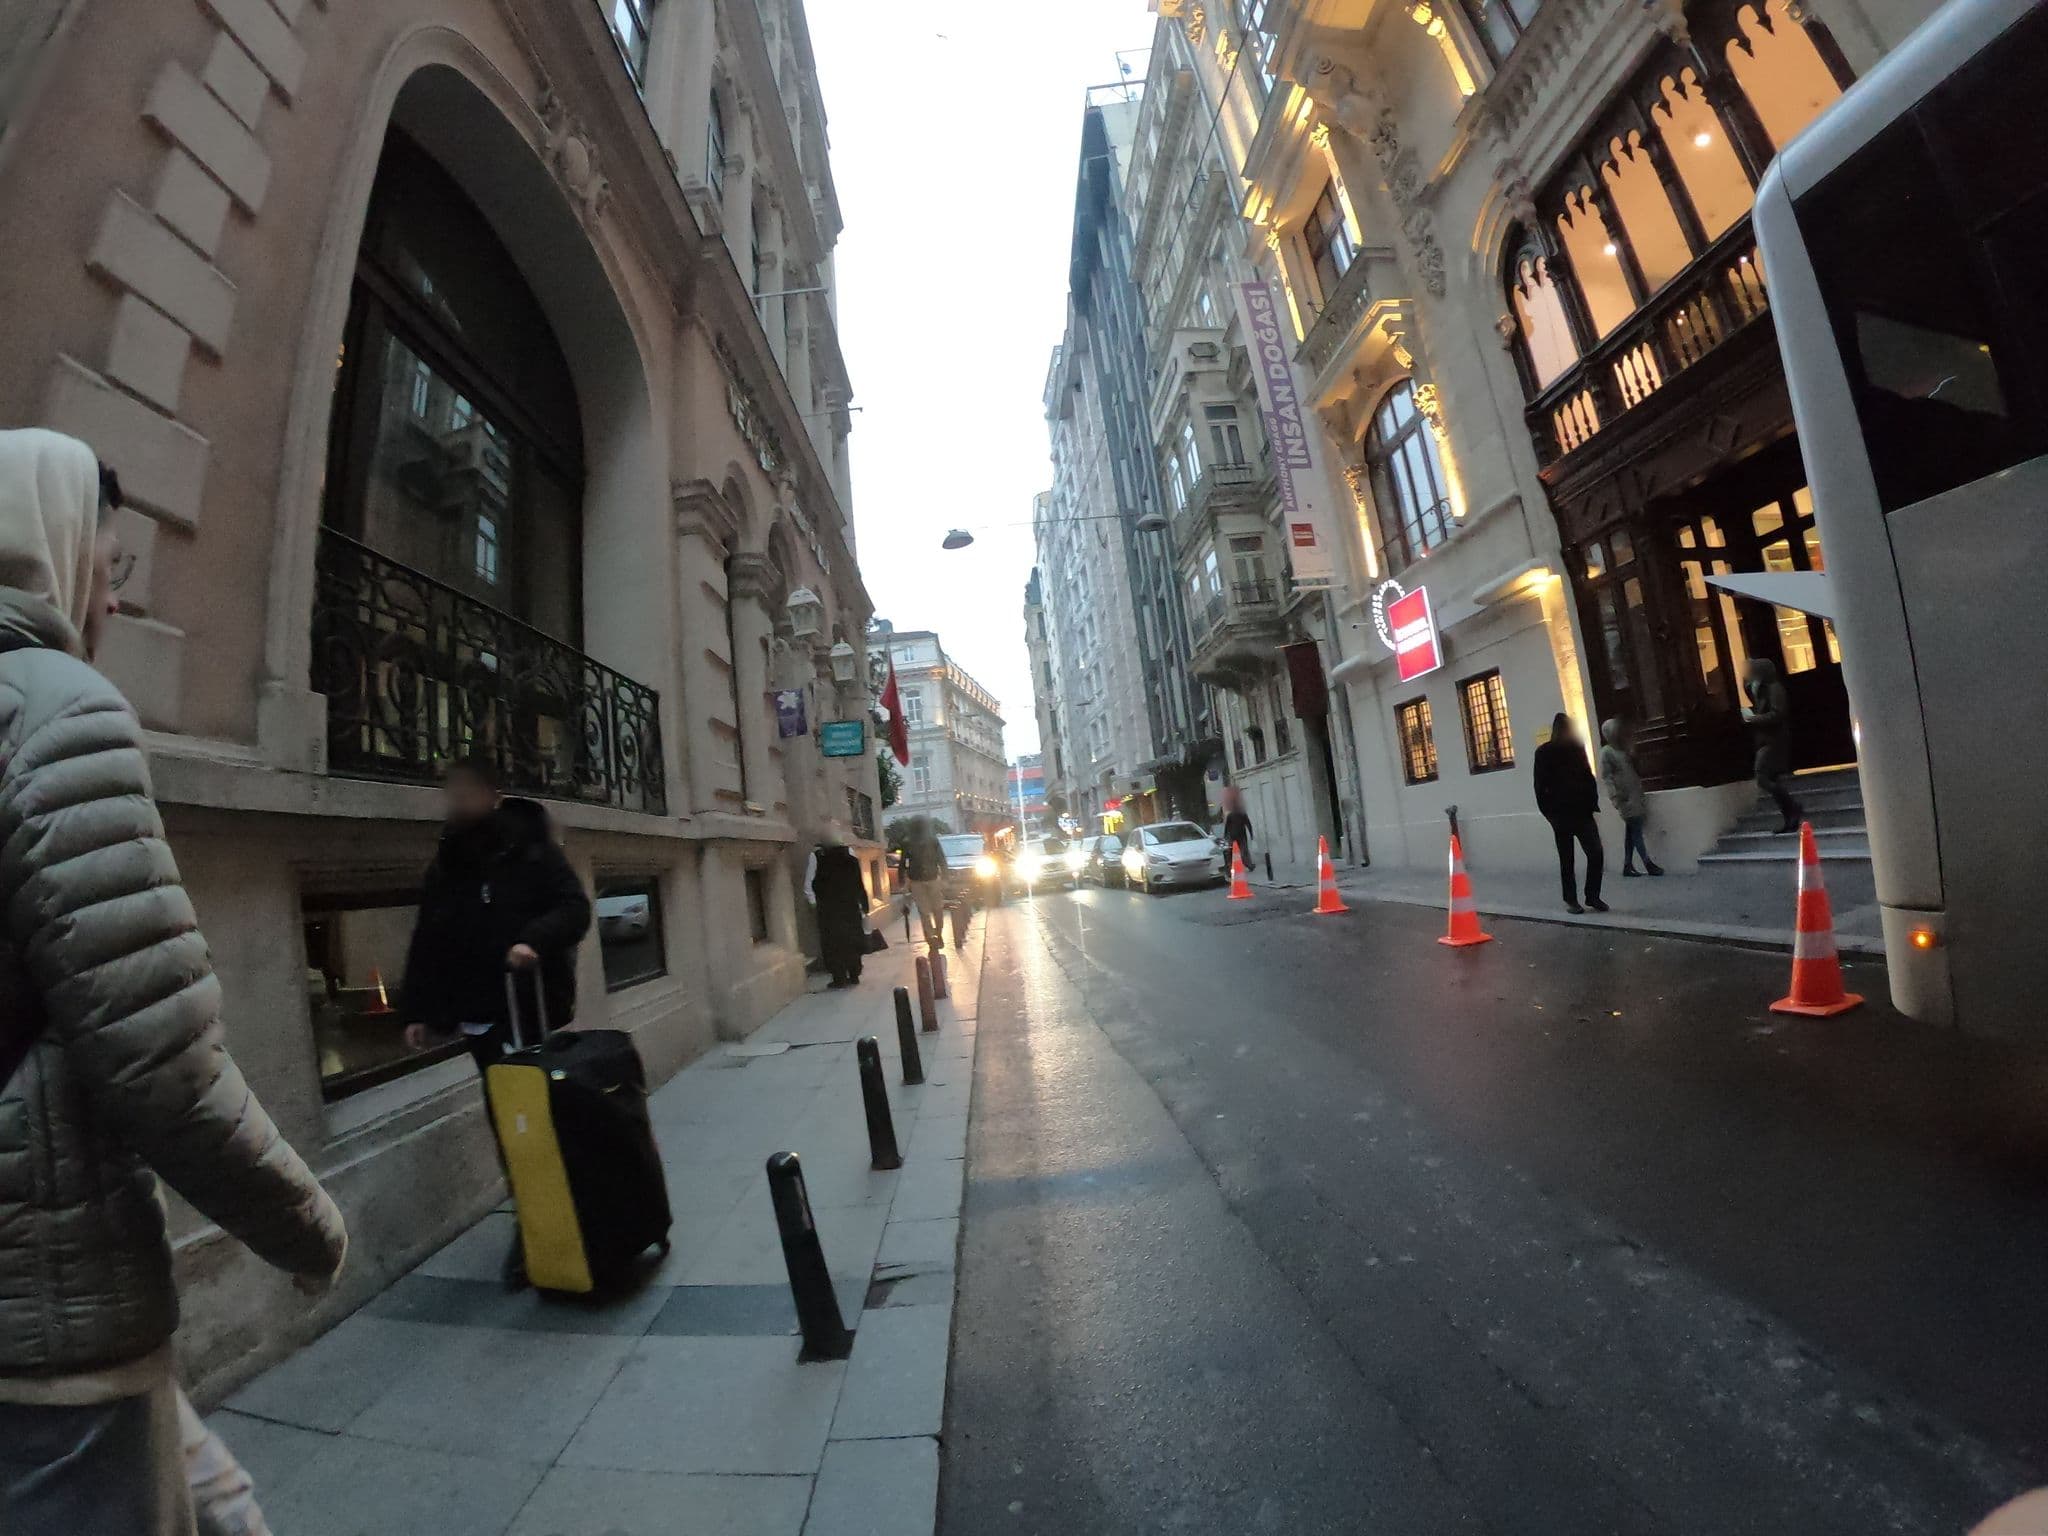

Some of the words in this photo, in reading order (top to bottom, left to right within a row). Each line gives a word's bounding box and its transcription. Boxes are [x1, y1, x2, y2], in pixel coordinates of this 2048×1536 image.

[1248, 290, 1288, 379] DOĞASI
[1273, 385, 1308, 465] İNSAN
[1276, 456, 1295, 508] ANTHONY
